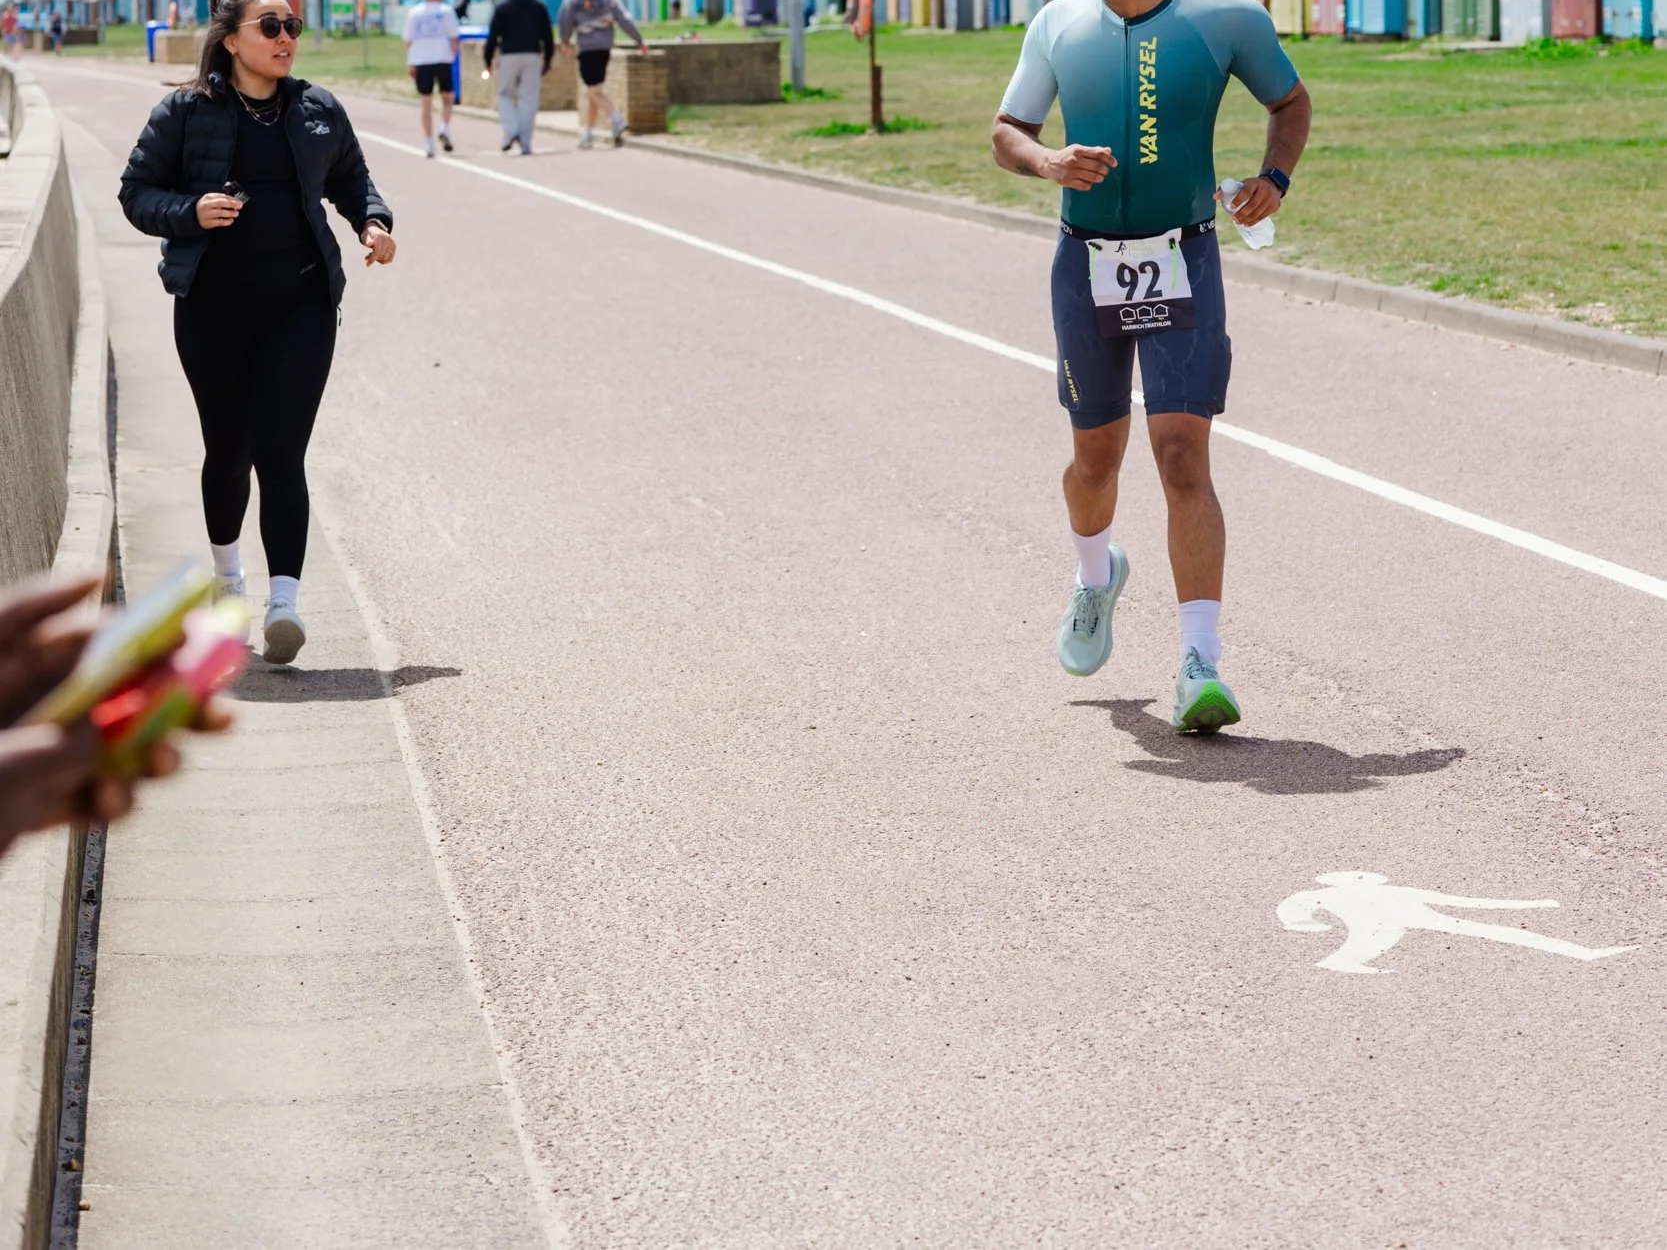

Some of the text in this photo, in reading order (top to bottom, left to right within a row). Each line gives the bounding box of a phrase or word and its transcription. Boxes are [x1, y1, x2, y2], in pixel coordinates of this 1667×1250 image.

[1139, 37, 1158, 164] VAN RYSEL
[1116, 260, 1163, 301] 92
[1144, 321, 1171, 329] TRIATHLON
[1068, 379, 1078, 402] RYSEL
